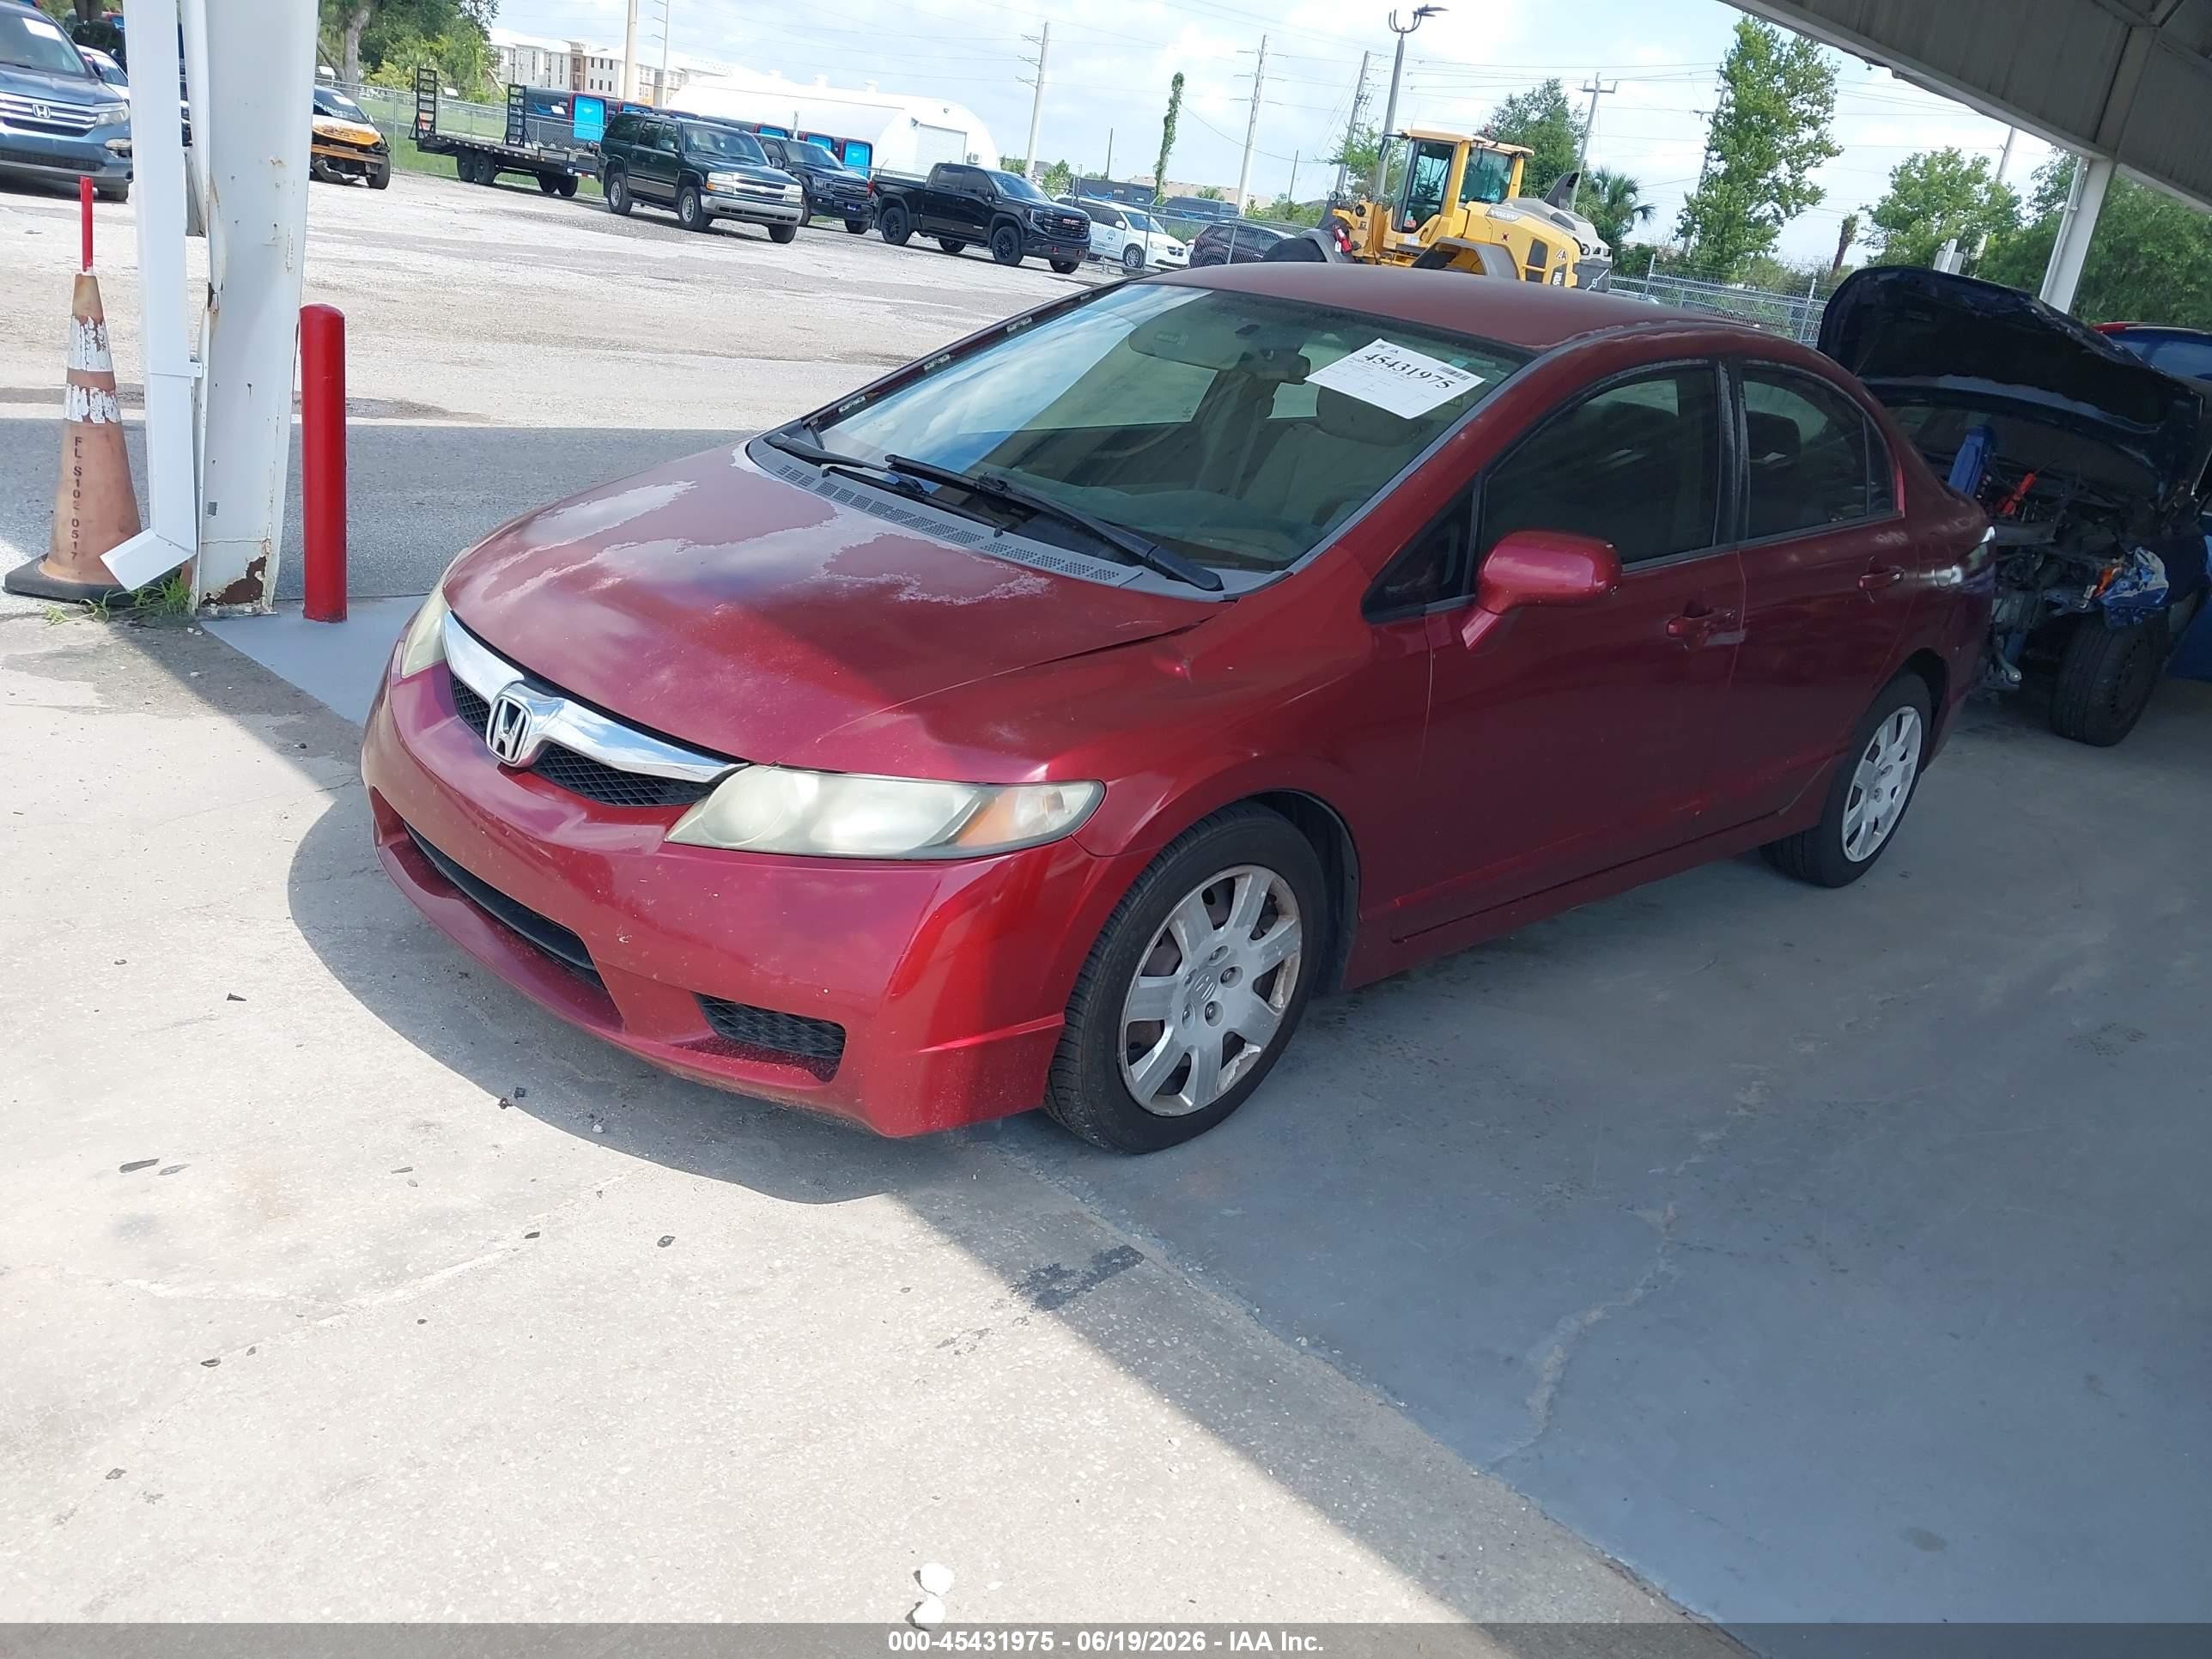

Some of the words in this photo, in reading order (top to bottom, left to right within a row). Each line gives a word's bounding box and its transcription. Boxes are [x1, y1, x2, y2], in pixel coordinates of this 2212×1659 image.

[1491, 210, 1518, 221] VOLVO
[1364, 354, 1456, 389] 45431975
[74, 436, 82, 459] FL
